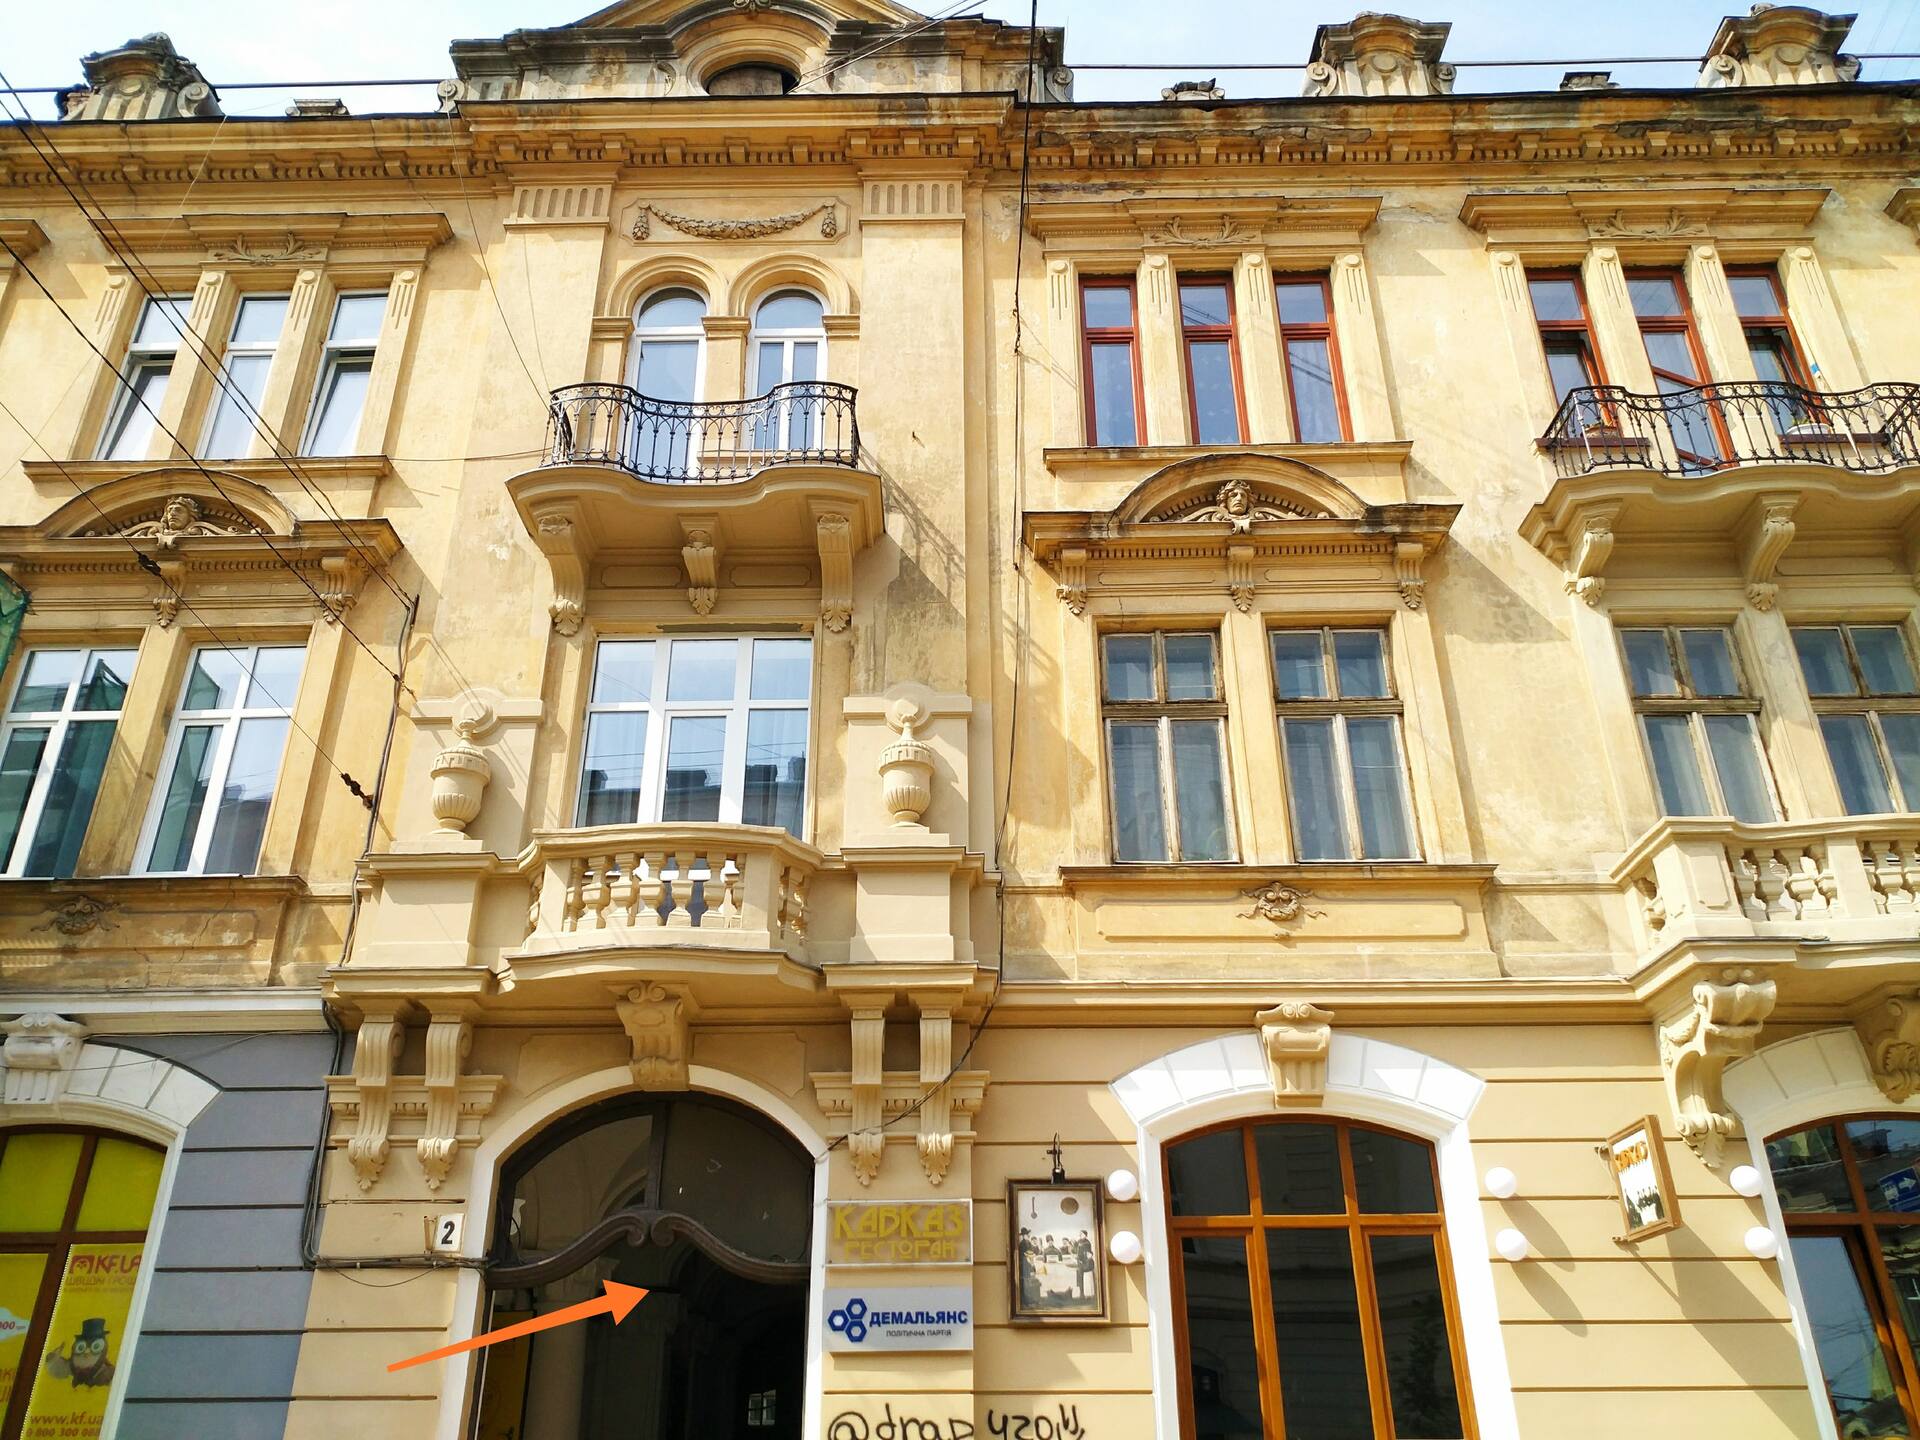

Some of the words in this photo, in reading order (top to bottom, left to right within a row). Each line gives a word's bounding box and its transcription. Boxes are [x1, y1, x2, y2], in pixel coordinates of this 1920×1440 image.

[441, 1220, 456, 1245] 2
[869, 1310, 968, 1328] ДЕМАЛЬЯНС
[886, 1329, 926, 1338] ПОЛІТИЧНА
[926, 1329, 952, 1338] ПАРТІЯ
